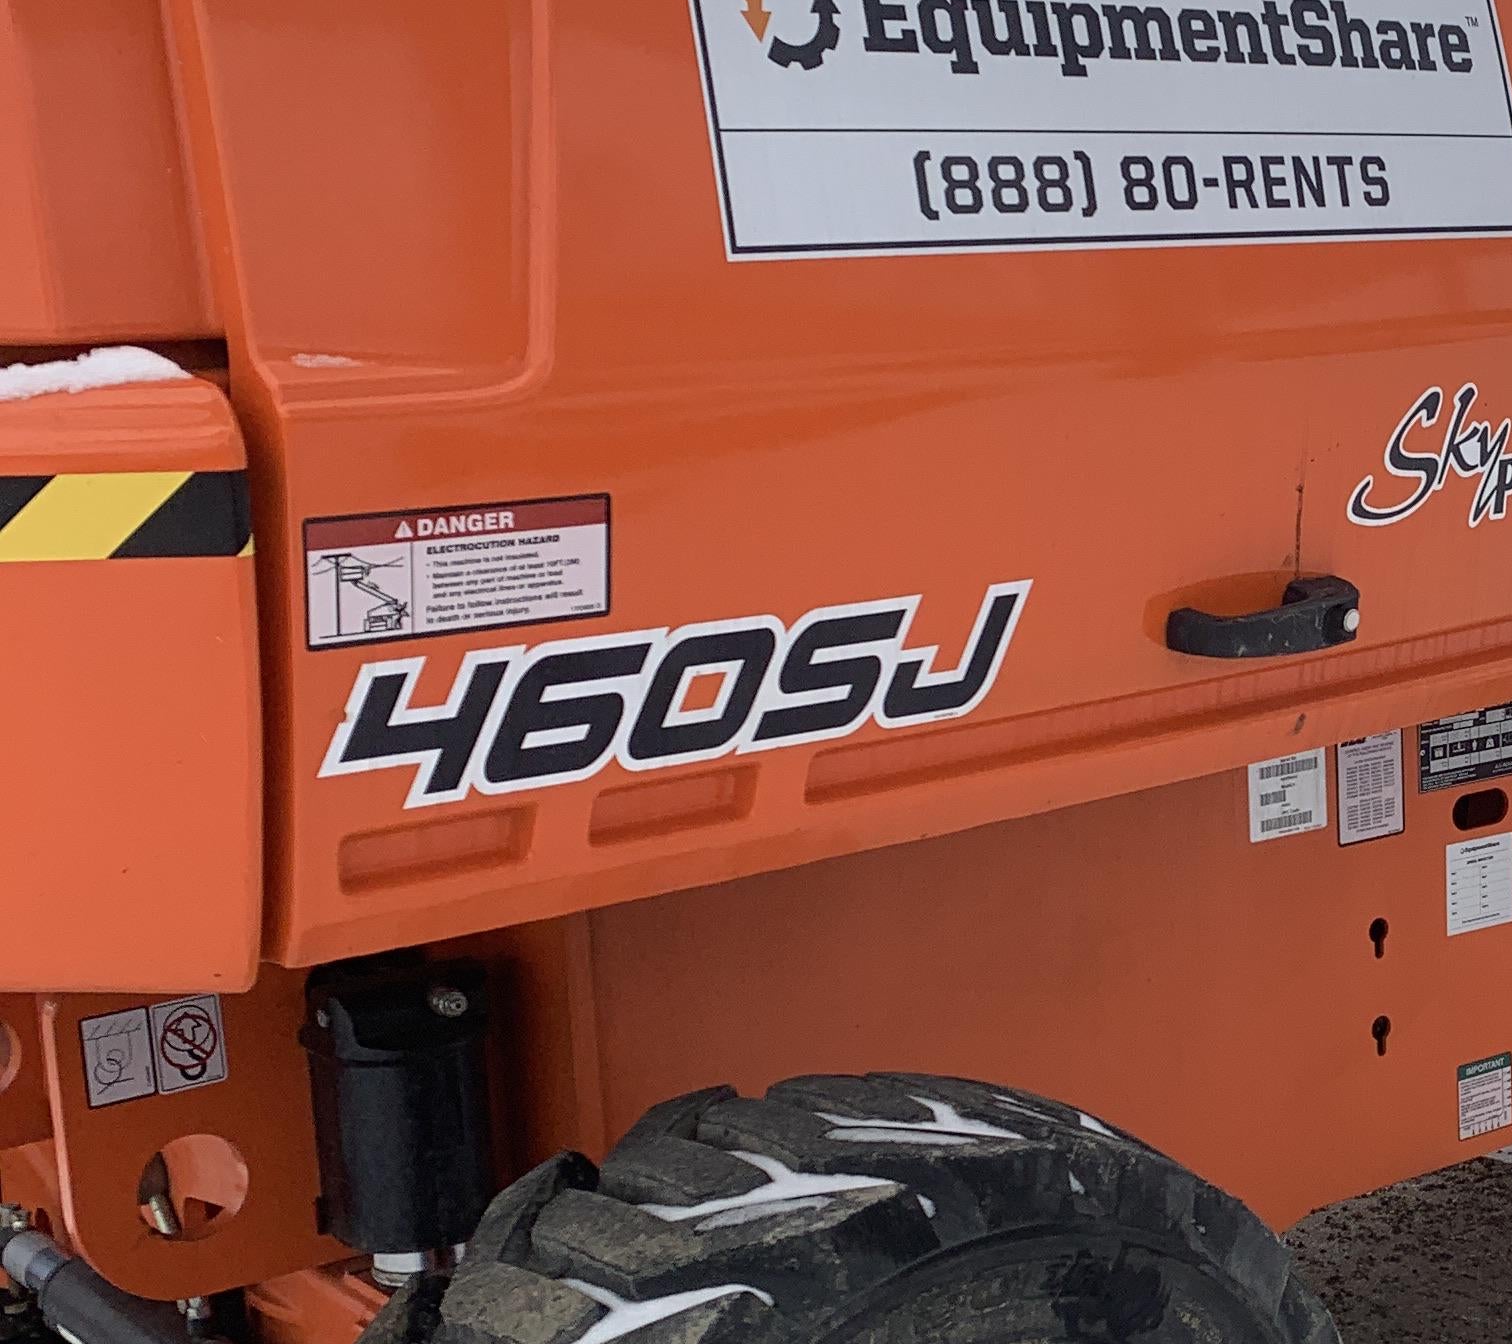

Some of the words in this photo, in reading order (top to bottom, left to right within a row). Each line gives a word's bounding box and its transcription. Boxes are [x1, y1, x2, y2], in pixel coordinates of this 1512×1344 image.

[913, 150, 1098, 221] (888)
[1120, 154, 1390, 211] 80-RENTS
[417, 511, 515, 537] DANGER
[426, 539, 515, 555] ELECTROCUTION
[518, 534, 560, 546] HAZARD
[337, 591, 1023, 796] 460SJ
[1465, 1056, 1505, 1076] IMPORTANT
